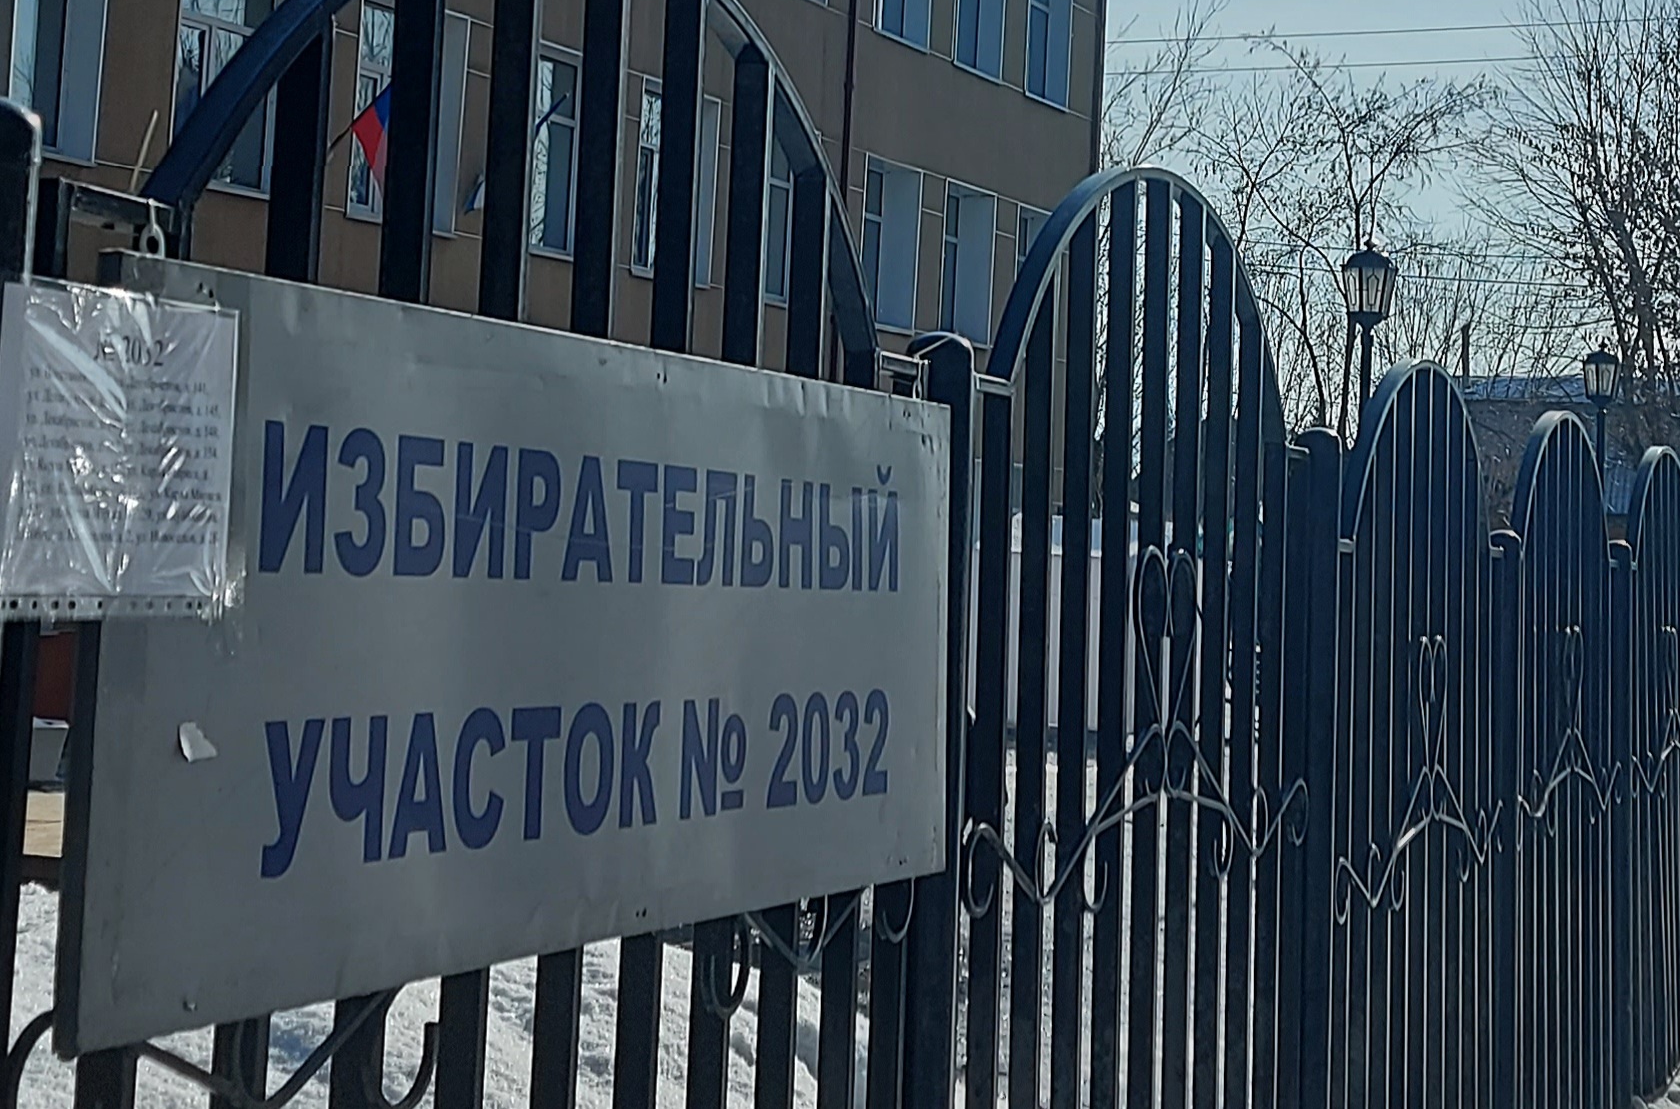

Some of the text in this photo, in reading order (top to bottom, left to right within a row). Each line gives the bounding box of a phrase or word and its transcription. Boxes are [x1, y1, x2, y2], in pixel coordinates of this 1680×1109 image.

[258, 419, 899, 593] ИЗБИРАТЕЛЬНЫЙ
[260, 689, 889, 880] УЧАСТОК № 2032
